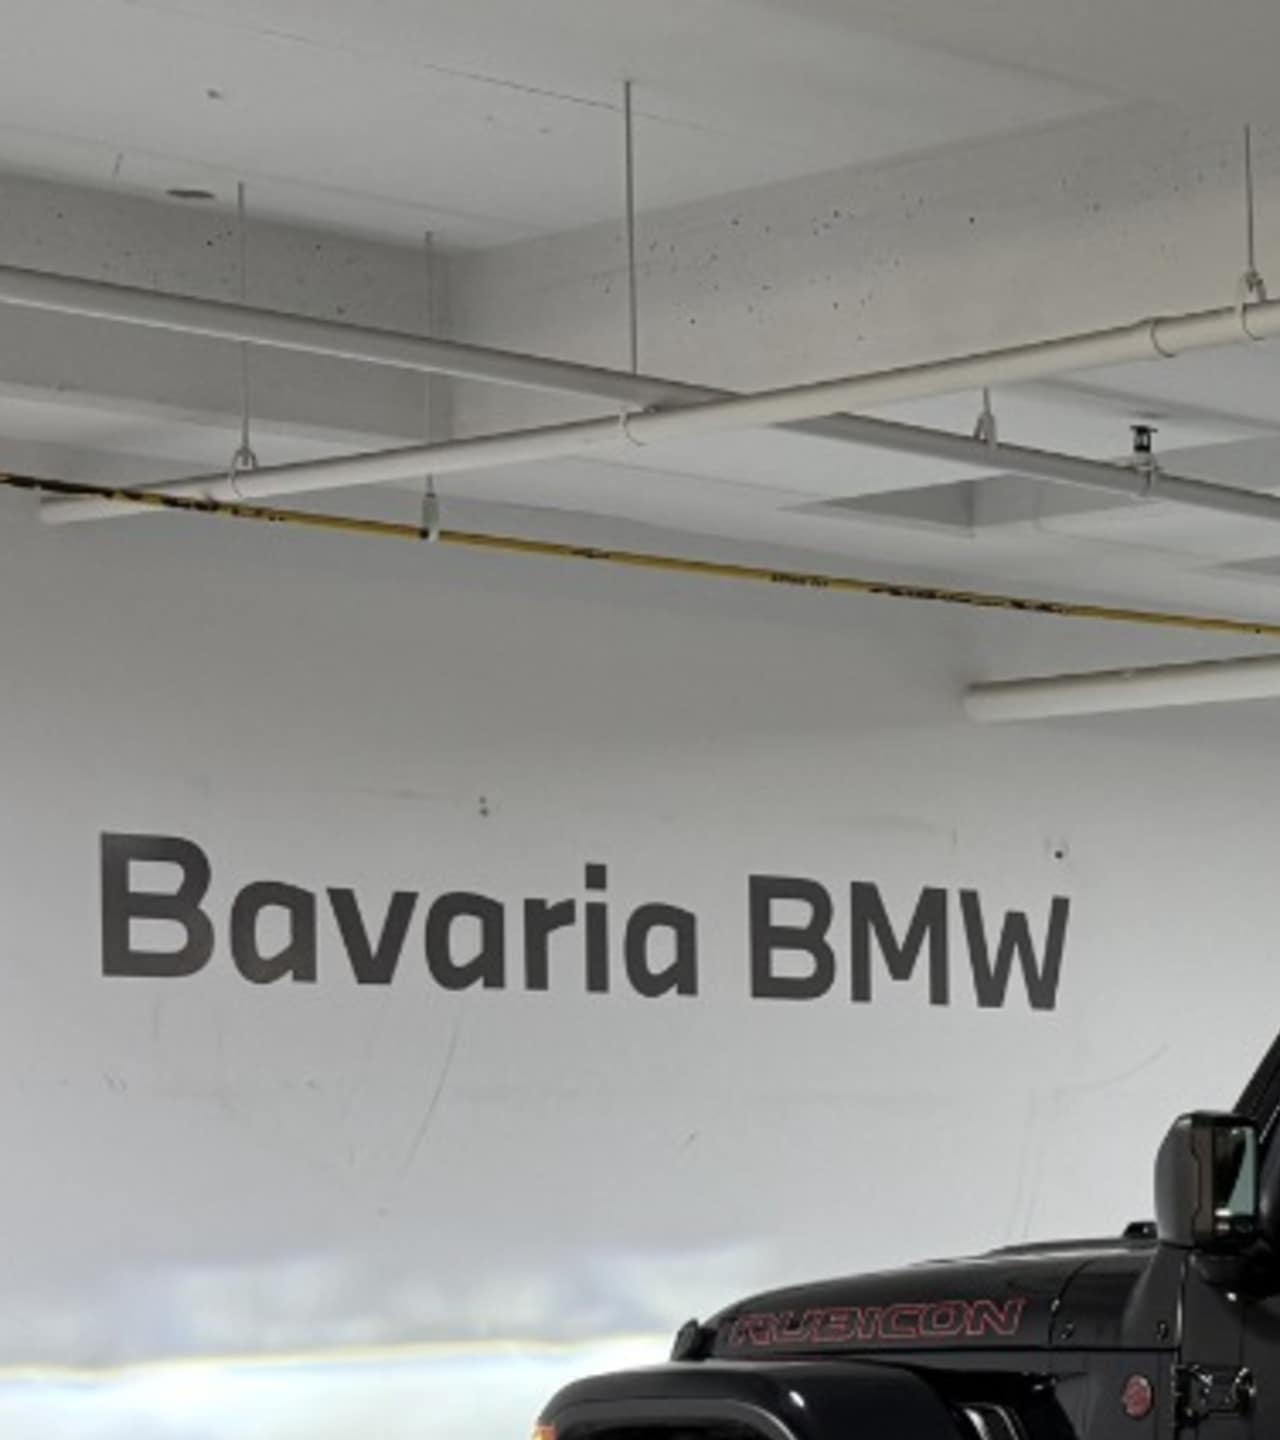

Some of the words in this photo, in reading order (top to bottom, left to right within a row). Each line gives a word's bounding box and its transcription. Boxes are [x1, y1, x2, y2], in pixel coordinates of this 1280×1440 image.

[100, 831, 698, 998] Bavaria
[748, 873, 1071, 1011] BMW
[730, 1298, 1027, 1345] RUBICON
